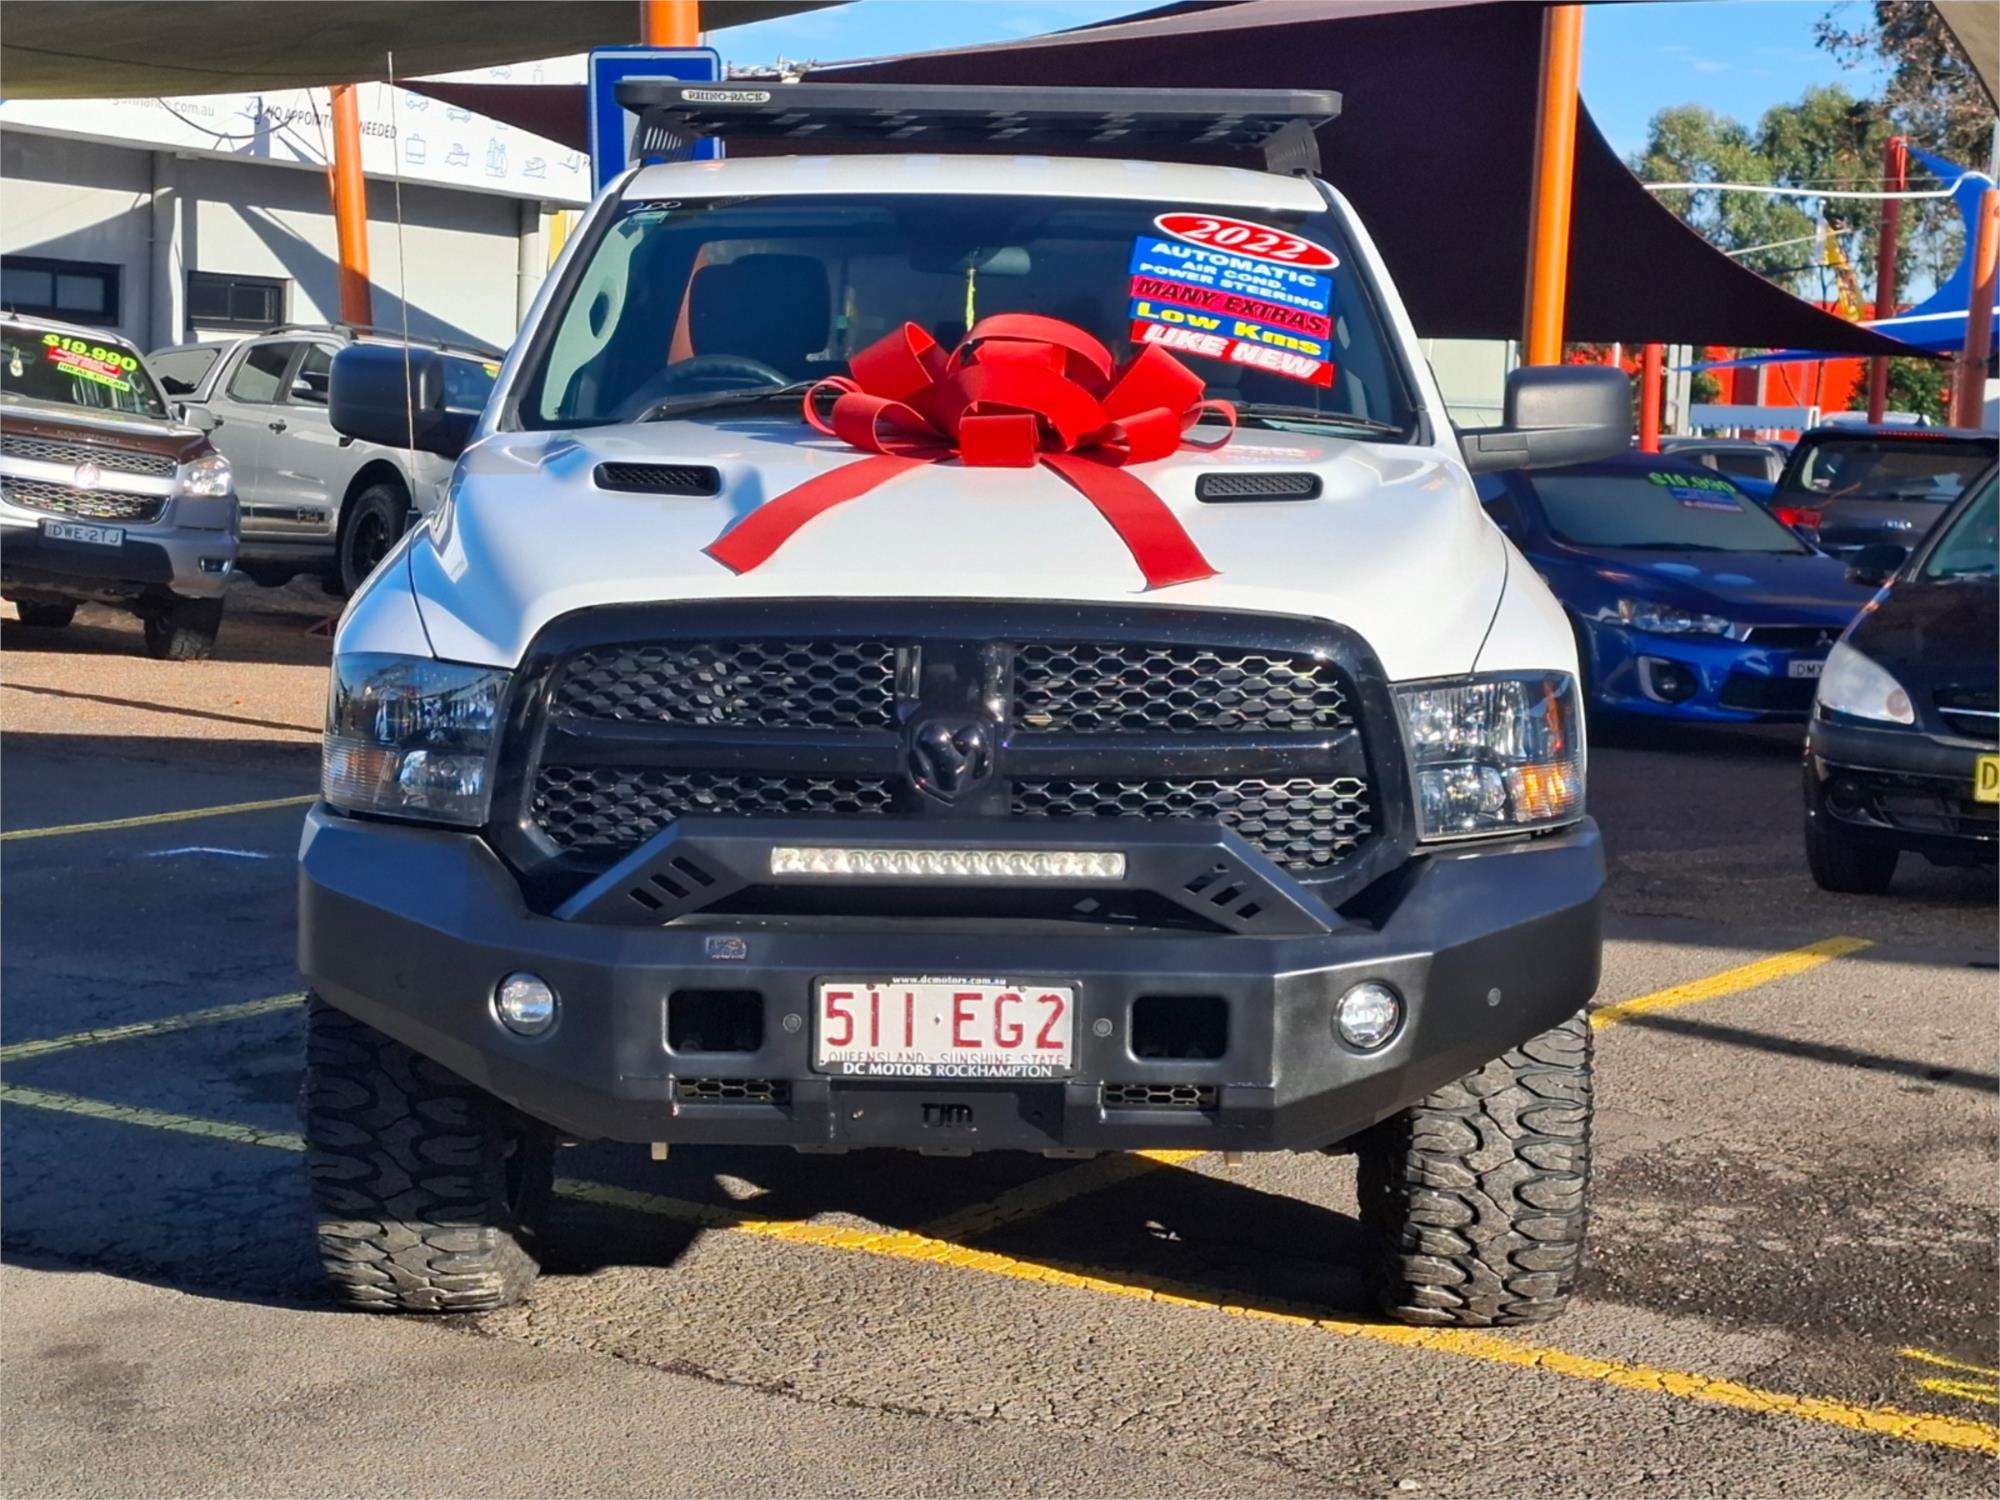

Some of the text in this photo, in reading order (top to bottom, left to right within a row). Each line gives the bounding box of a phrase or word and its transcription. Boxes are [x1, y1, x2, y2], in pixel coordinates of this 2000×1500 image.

[687, 90, 766, 102] RHINO-RACK
[266, 105, 398, 140] NO APPOINT NEEDED
[1179, 220, 1310, 259] 2022
[1151, 243, 1317, 288] AUTOMATIC
[1182, 261, 1288, 292] AIR COND.
[1139, 263, 1325, 311] POWER STEERING
[1137, 279, 1326, 333] MANY EXTRAS
[1143, 324, 1322, 379] LIKE NEW
[1233, 321, 1322, 356] Kms
[891, 974, 1007, 985] www.dcmotors.com.au
[828, 1052, 925, 1064] QUEENSLAND
[940, 1052, 1012, 1065] SUNSHINE
[1021, 1053, 1066, 1066] STATE
[843, 1063, 1053, 1078] DC MOTORS ROCKHAMPTON
